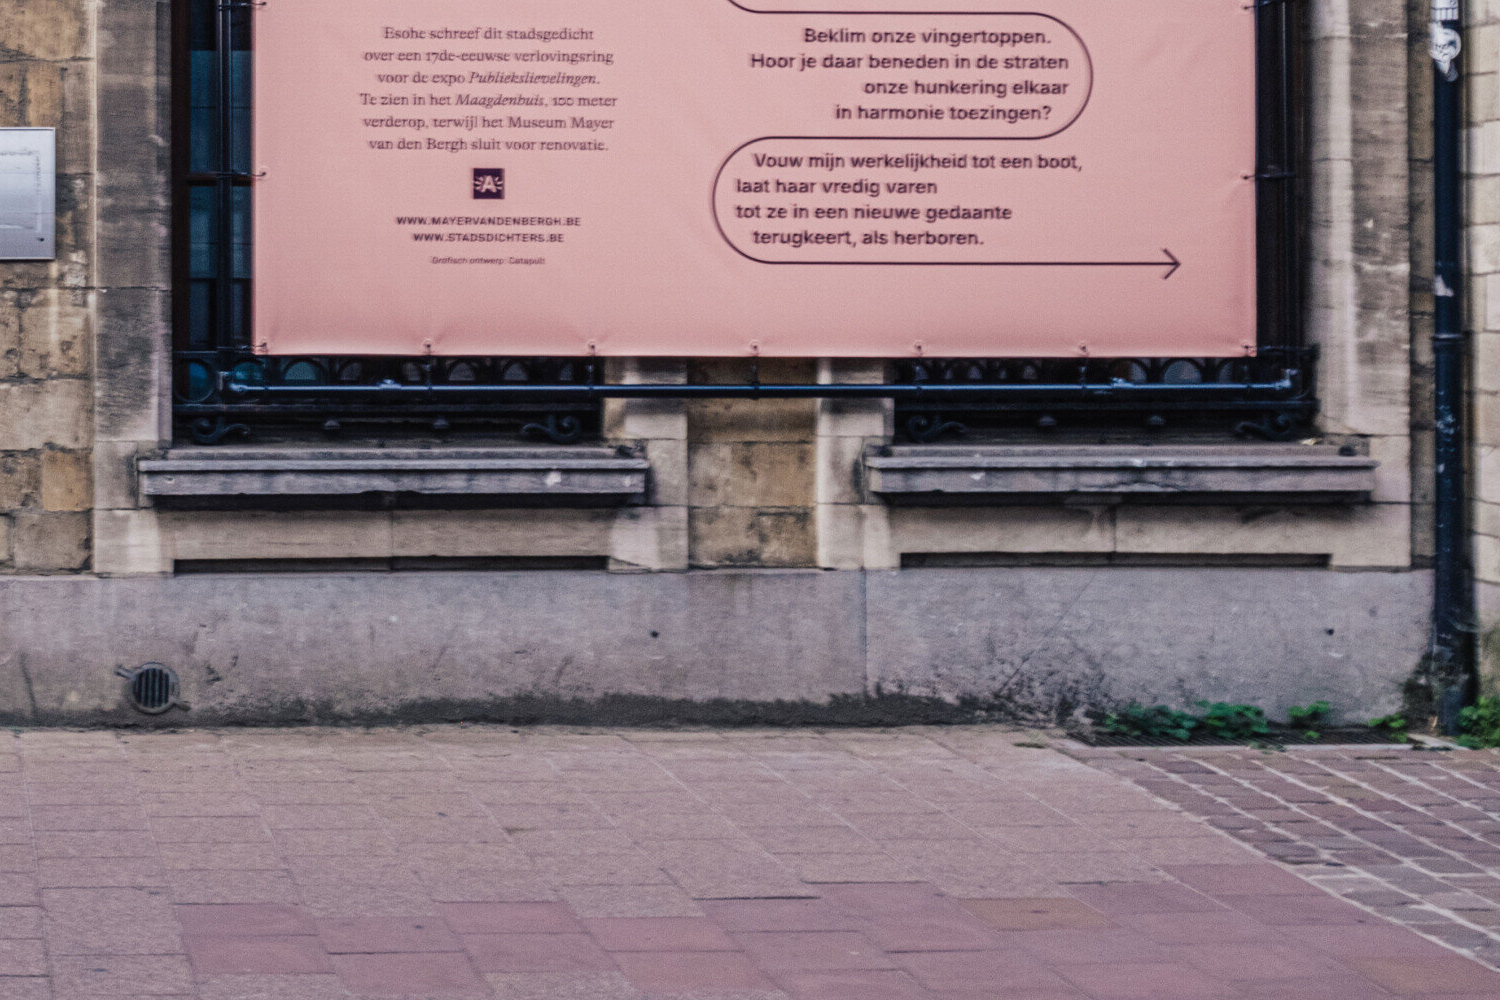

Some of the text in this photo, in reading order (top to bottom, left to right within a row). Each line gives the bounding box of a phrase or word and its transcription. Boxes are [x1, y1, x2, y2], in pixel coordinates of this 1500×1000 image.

[384, 27, 593, 42] Esohe schreef dit stadsgedicht
[803, 27, 1051, 47] Beklim onze vingertoppen.
[364, 50, 613, 65] over een 17de-eeuwse verlovingsring
[750, 53, 1069, 72] Hoor je daar beneden in de straten
[377, 71, 599, 87] voor de expo Publiekslievelingen.
[863, 80, 1069, 98] onze hunkering elkaar
[360, 93, 377, 105] Te
[380, 94, 408, 105] zien
[413, 94, 425, 105] in
[430, 94, 451, 105] het
[455, 94, 548, 109] Maagdenhuis,
[577, 97, 617, 106] meter
[835, 104, 1052, 124] in harmonie toezingen?
[363, 116, 614, 132] verderop, terwijl het Museum Mayer
[369, 138, 609, 153] van den Bergh sluit voor renovatie.
[753, 153, 1082, 172] Vouw mijn werkelijkheid tot een boot,
[736, 179, 937, 198] laat haar vredig varen
[395, 216, 580, 226] WWW.MAYERVANDENBERGH.BE
[734, 204, 1012, 223] tot ze in een nieuwe gedaante
[412, 233, 564, 243] WWW.STADSDICHTERS.BE
[752, 230, 984, 248] terugkeert, als herboren.
